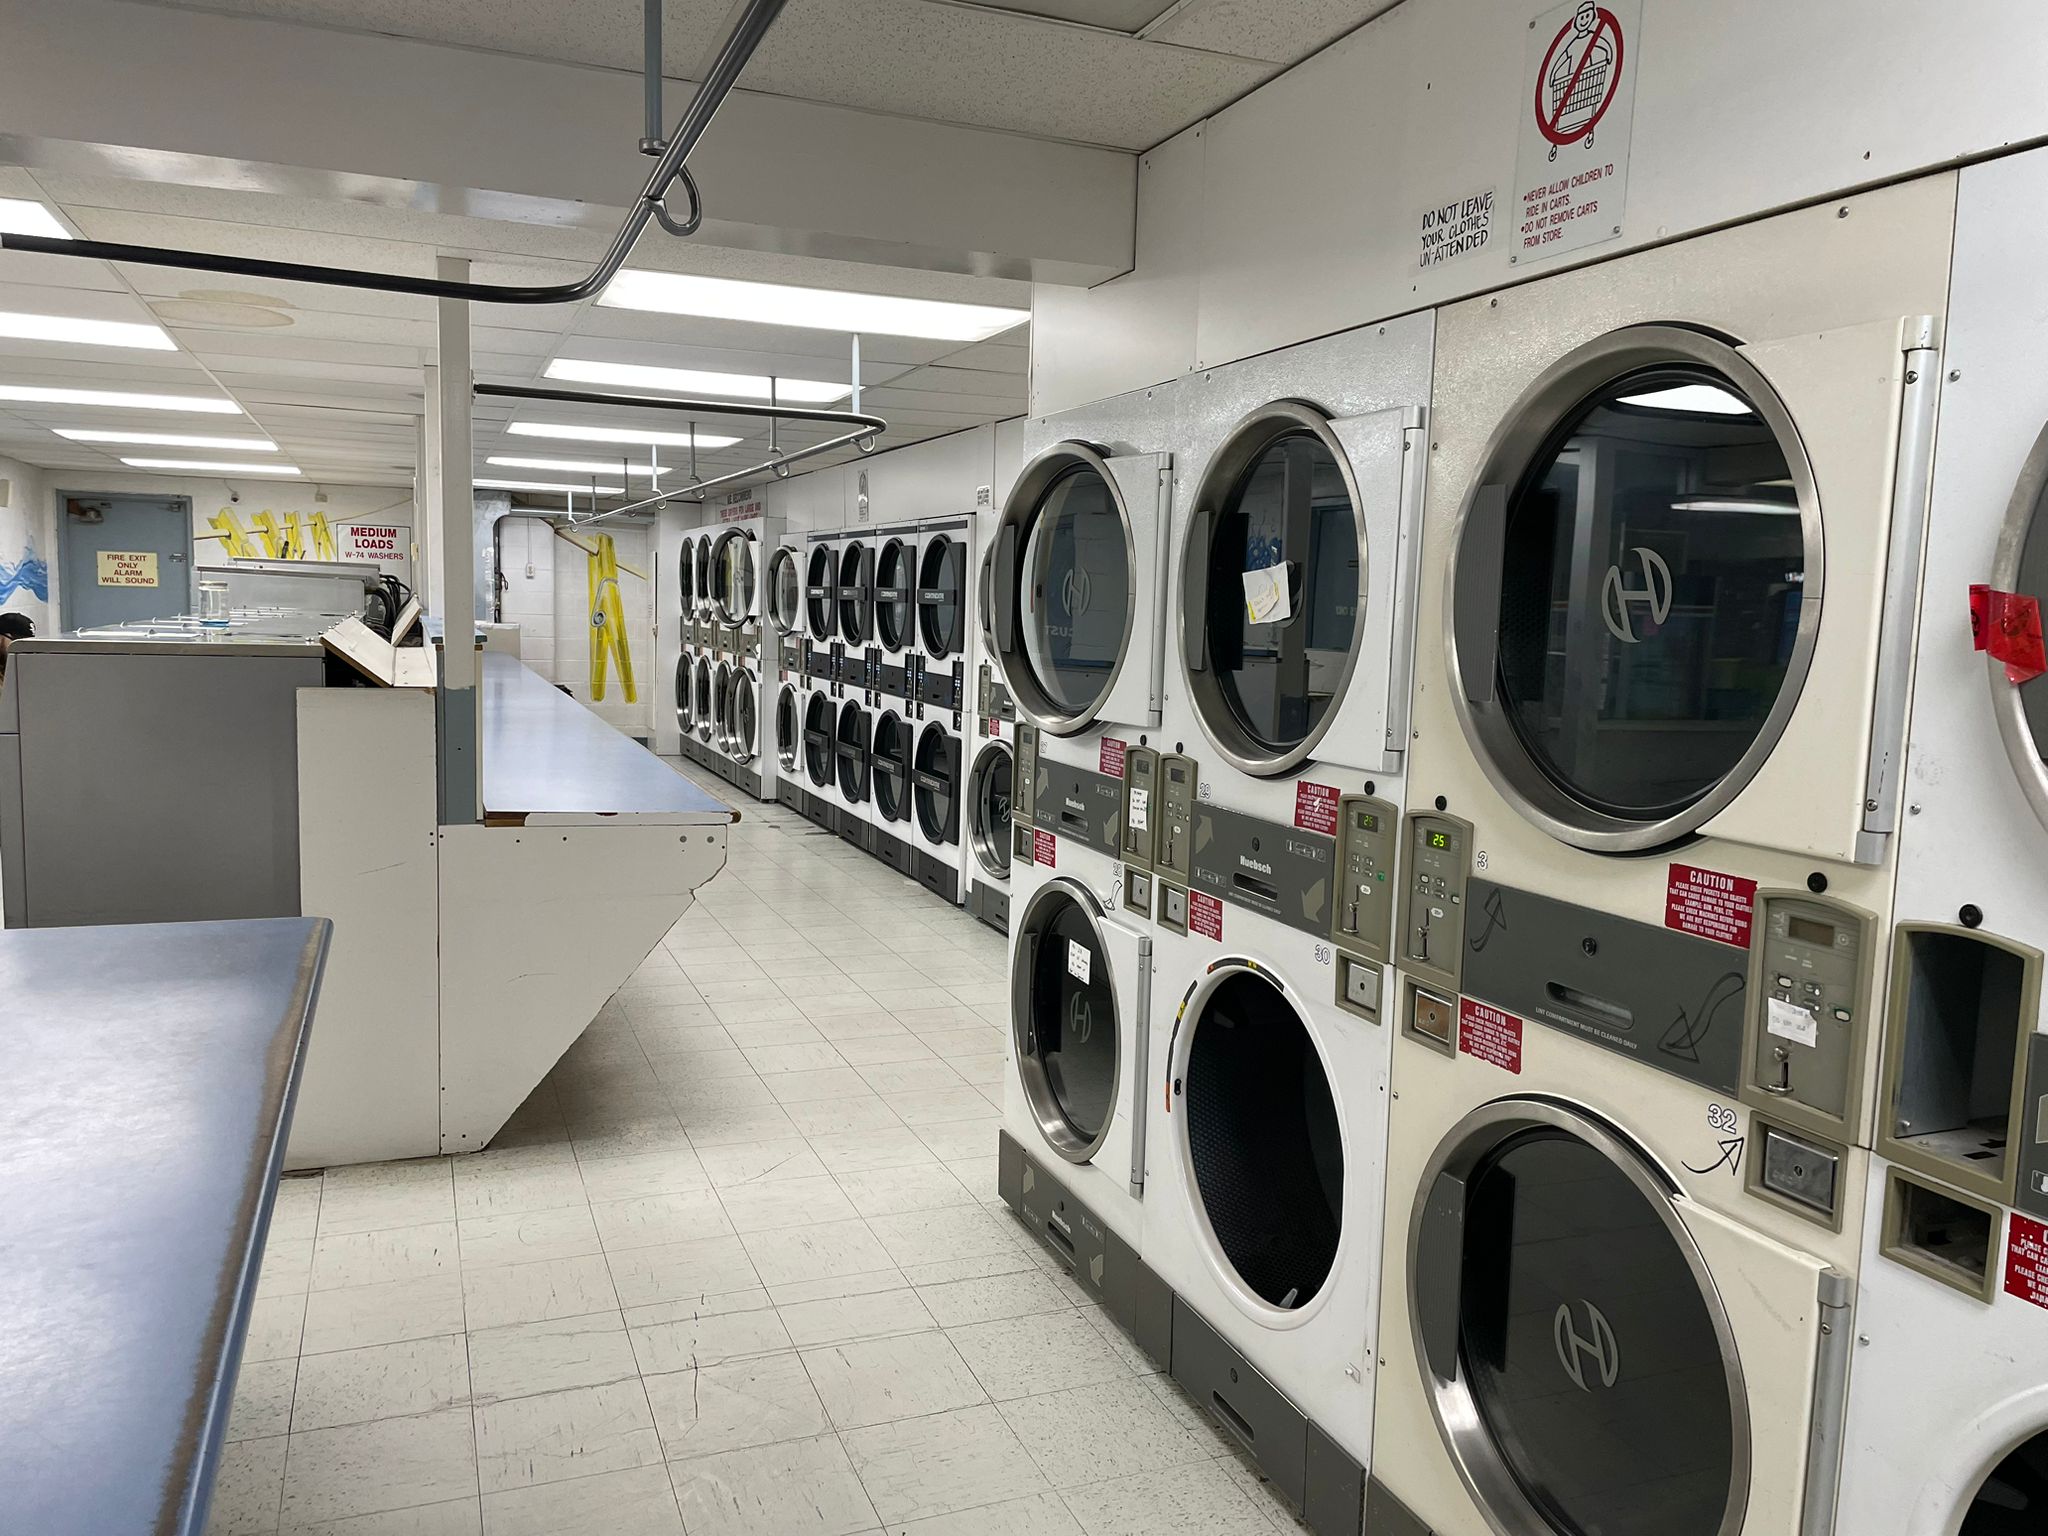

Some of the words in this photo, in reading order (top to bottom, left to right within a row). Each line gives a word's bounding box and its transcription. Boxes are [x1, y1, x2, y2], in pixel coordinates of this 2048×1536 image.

[1548, 178, 1569, 196] ALLOW
[1571, 167, 1603, 188] CHILDREN
[1605, 163, 1614, 176] TO
[1423, 210, 1435, 230] DO
[1437, 202, 1459, 226] NOT
[1461, 191, 1493, 218] LEAVE
[1525, 221, 1534, 234] DO
[1536, 216, 1548, 230] NOT
[1550, 208, 1575, 226] REMOVE
[1577, 201, 1598, 217] CARTS
[1526, 204, 1539, 218] RIDE
[1541, 202, 1548, 213] IN
[1422, 228, 1445, 250] YOUR
[1449, 211, 1489, 239] CLOTHES
[1523, 234, 1541, 249] FROM
[1542, 227, 1563, 244] STORE.
[1420, 230, 1488, 267] UN-ATTENDED
[351, 527, 396, 537] MEDIUM
[355, 539, 394, 549] LOADS
[1200, 782, 1211, 799] 29
[1433, 834, 1445, 847] 25
[1240, 855, 1272, 875] Huebsch
[1676, 881, 1689, 889] PLEASE
[1690, 884, 1702, 893] CHECK
[1703, 888, 1720, 898] POCKETS
[1690, 871, 1734, 891] CAUTION
[1672, 903, 1685, 912] PLEASE
[1686, 907, 1698, 915] CHECK
[1688, 892, 1701, 900] CAUSE
[1701, 895, 1717, 904] DAMAGE
[1724, 900, 1734, 908] YOUR
[1315, 944, 1330, 965] 30
[1475, 1006, 1506, 1026] CAUTION
[1536, 1007, 1545, 1015] LINT
[1546, 1011, 1580, 1028] COMPARTMENT
[1580, 1024, 1593, 1032] MUST
[1601, 1032, 1622, 1044] CLEANED
[1623, 1040, 1637, 1049] DAILY
[1708, 1103, 1737, 1135] 32
[2011, 1244, 2025, 1255] THAT
[2027, 1251, 2038, 1261] CAN
[2021, 1239, 2041, 1253] PLEASE
[2015, 1265, 2035, 1279] PLEASE
[2027, 1279, 2036, 1289] WE
